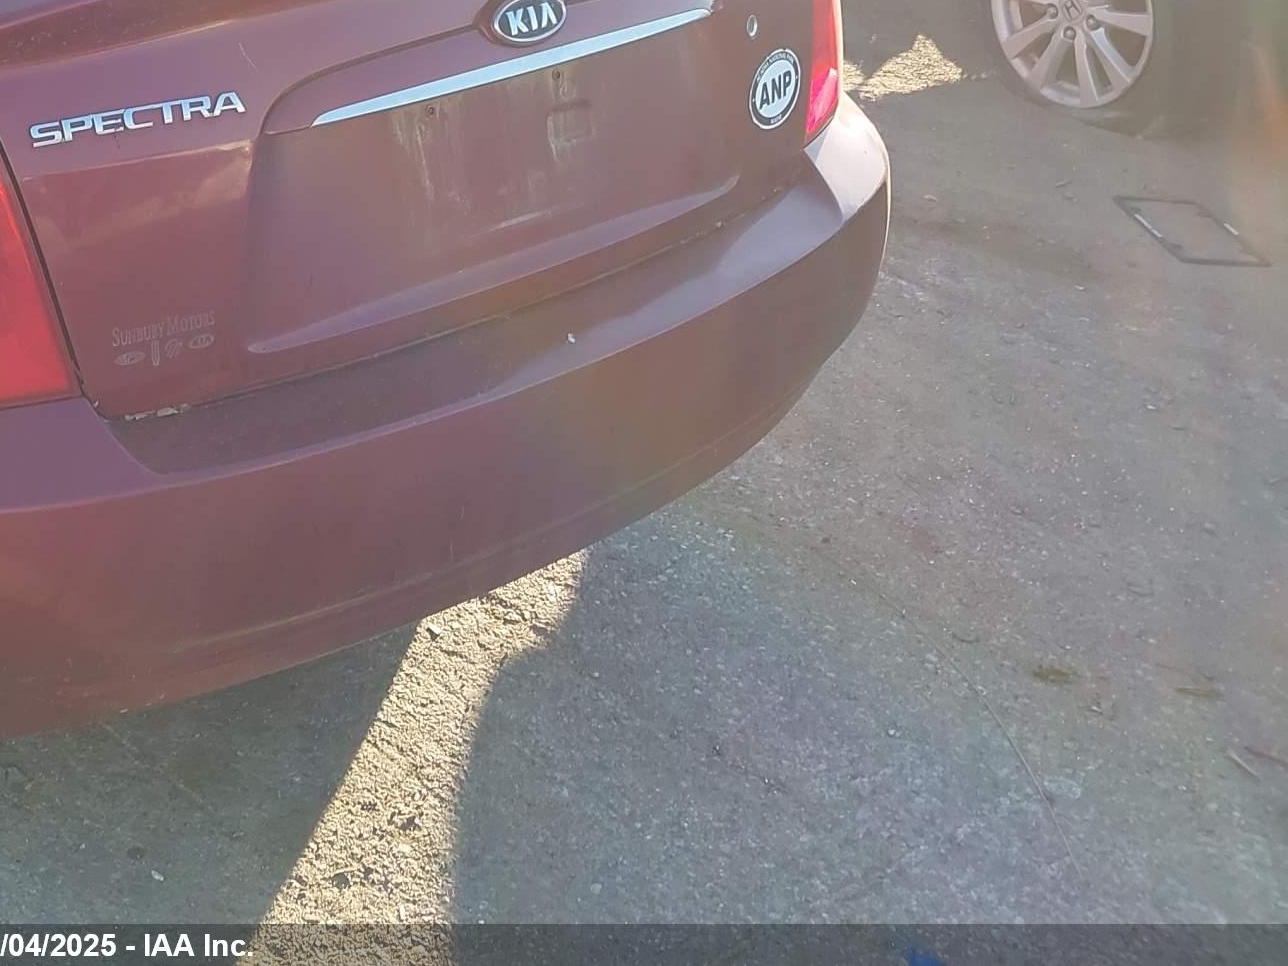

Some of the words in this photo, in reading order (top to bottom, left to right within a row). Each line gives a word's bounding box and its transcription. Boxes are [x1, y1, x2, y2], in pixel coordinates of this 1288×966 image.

[504, 0, 558, 37] KIA
[759, 70, 792, 110] ANP
[30, 91, 247, 148] SPECTRA
